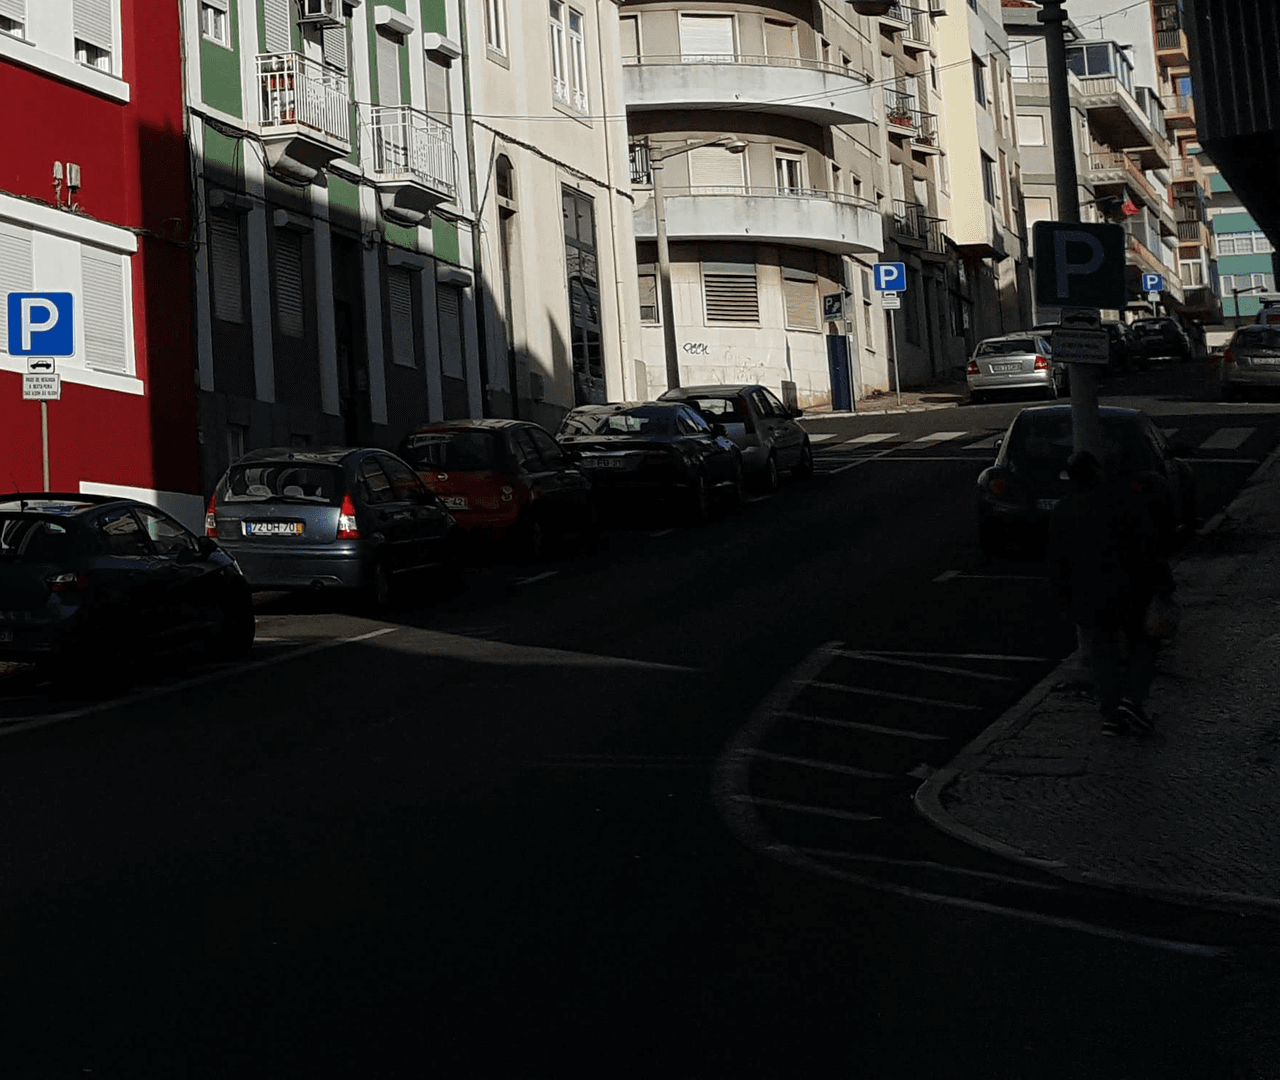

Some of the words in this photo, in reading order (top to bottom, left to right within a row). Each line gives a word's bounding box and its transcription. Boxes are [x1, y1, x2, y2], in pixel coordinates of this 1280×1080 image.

[1053, 230, 1105, 299] P
[879, 265, 898, 289] P
[1146, 275, 1158, 289] P
[825, 297, 834, 311] P
[20, 297, 60, 351] P
